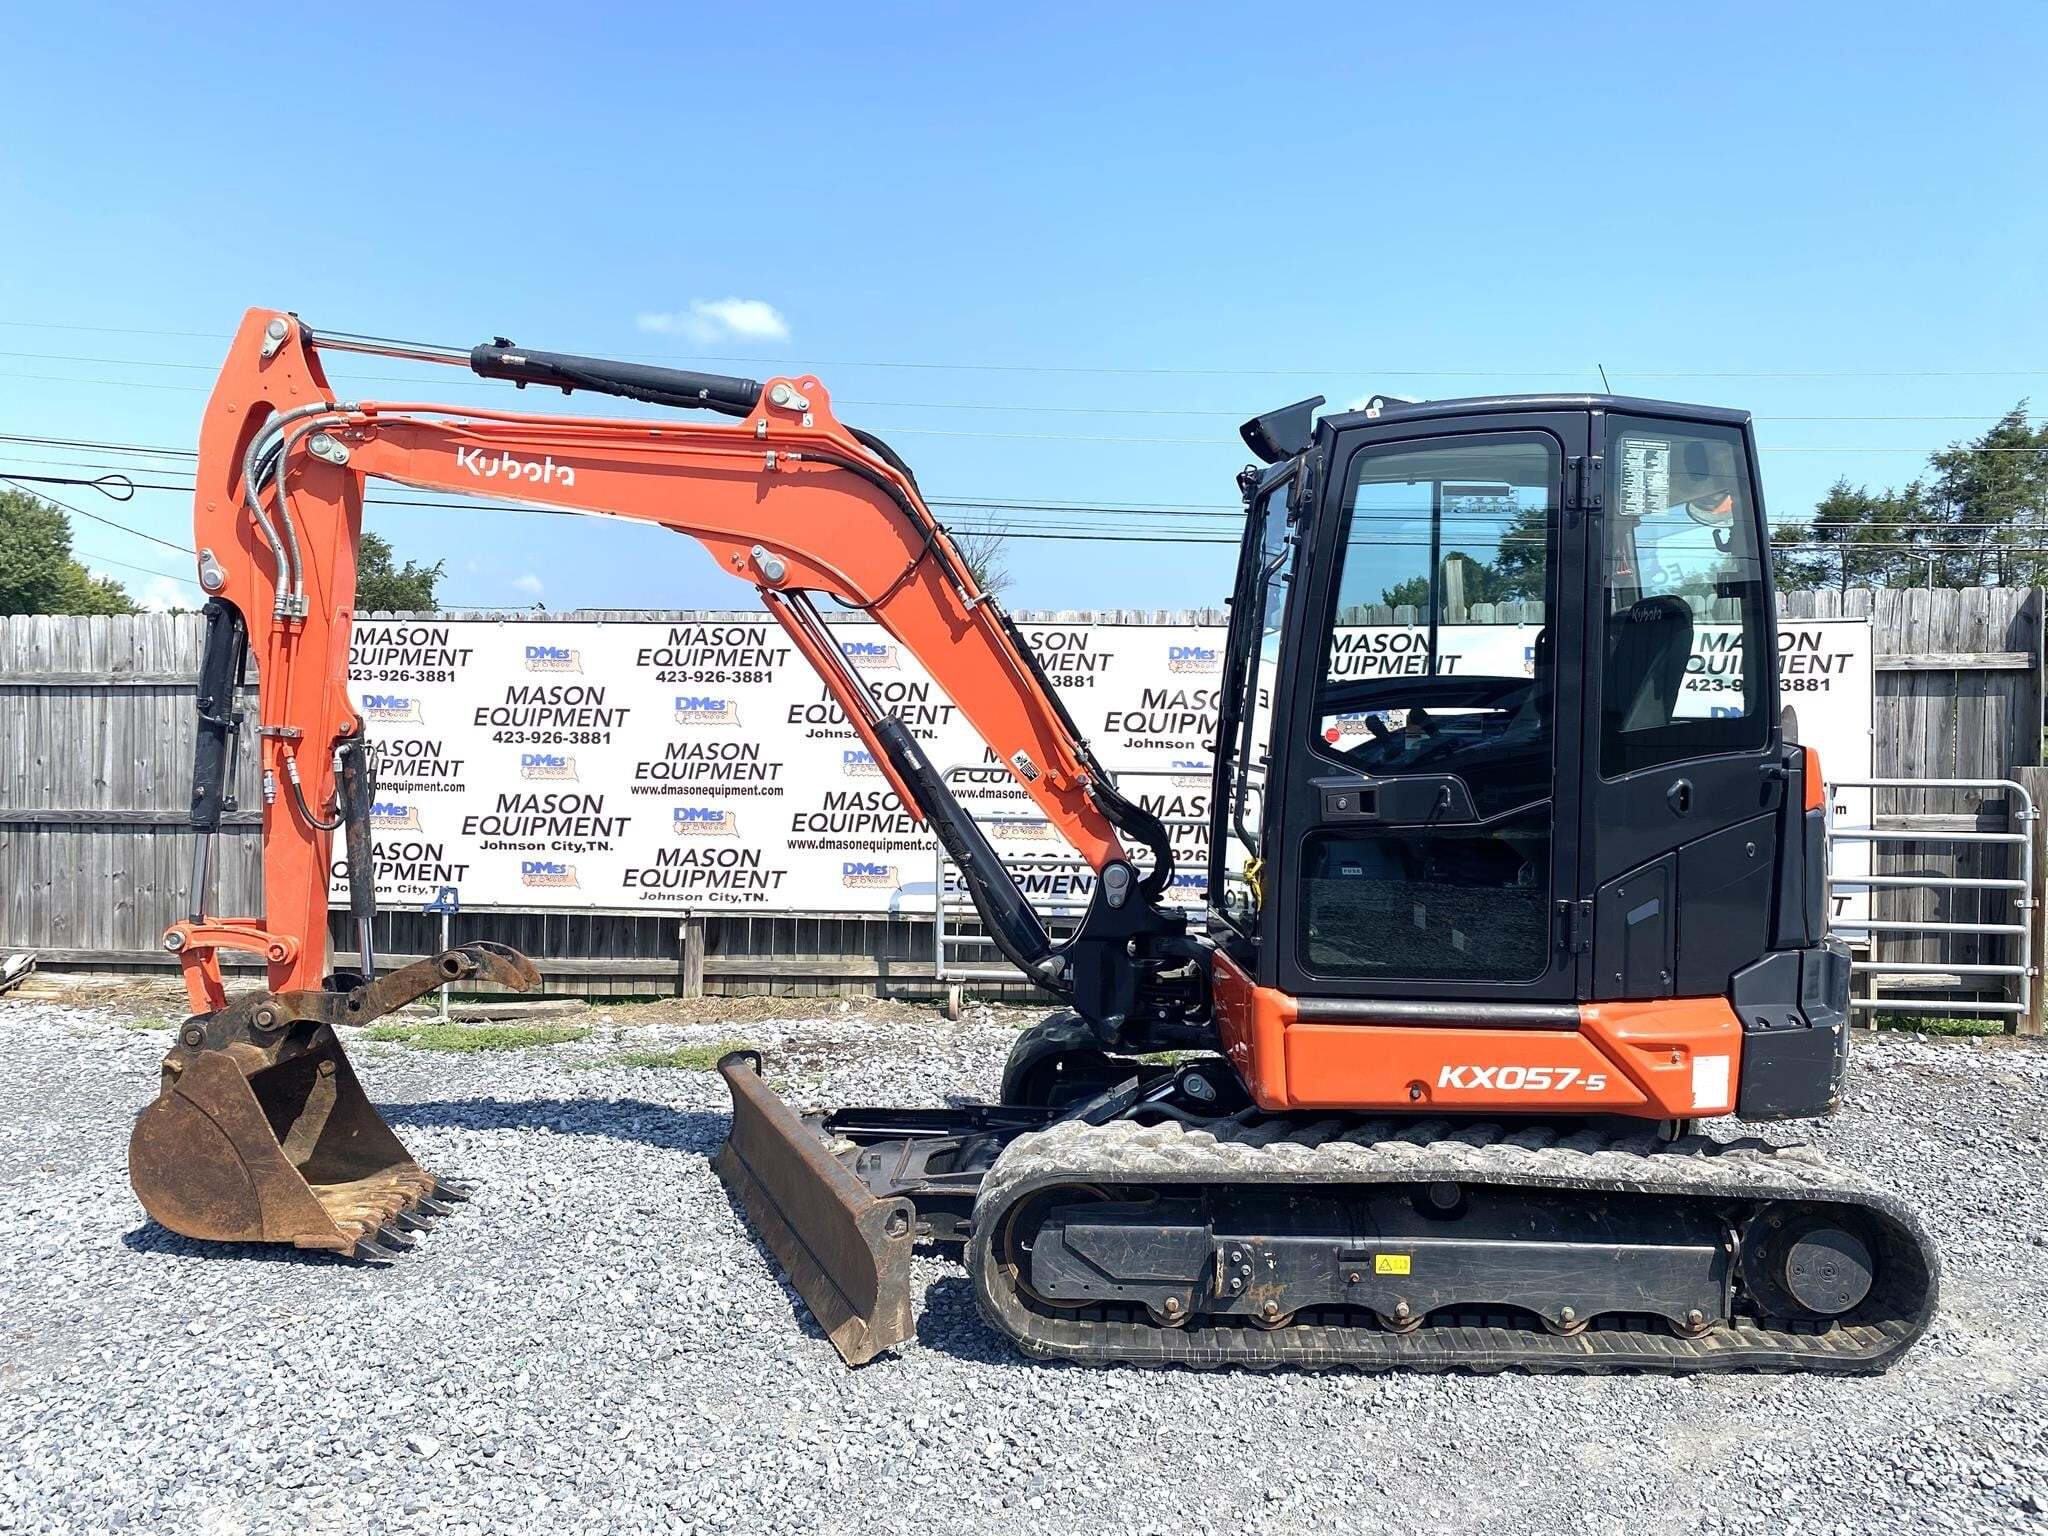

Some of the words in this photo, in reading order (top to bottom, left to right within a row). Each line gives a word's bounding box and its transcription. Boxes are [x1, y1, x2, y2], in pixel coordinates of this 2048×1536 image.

[456, 446, 575, 487] Kubota
[354, 627, 449, 646] MASON
[668, 628, 766, 646] MASON
[1700, 631, 1822, 652] MAON
[636, 648, 791, 667] EQUIPMENT
[656, 670, 772, 683] 423-926-3881
[505, 685, 605, 705] MASON
[473, 707, 630, 727] EQUIPMENT
[1104, 711, 1217, 734] EQUIPM
[493, 731, 611, 744] 423-926-3881
[1124, 738, 1194, 749] Johnson
[665, 743, 760, 760] MASON
[635, 762, 783, 780] EQUIPMENT
[631, 784, 784, 798] www.dmasonequipment.com
[496, 794, 604, 814] MASON
[462, 816, 631, 837] EQUIPMENT
[480, 841, 545, 851] Johnson
[551, 841, 614, 853] City,TN.
[656, 848, 761, 867] MASON
[622, 869, 788, 888] EQUIPMENT
[639, 892, 703, 901] Johnson
[709, 893, 768, 903] City,TN.
